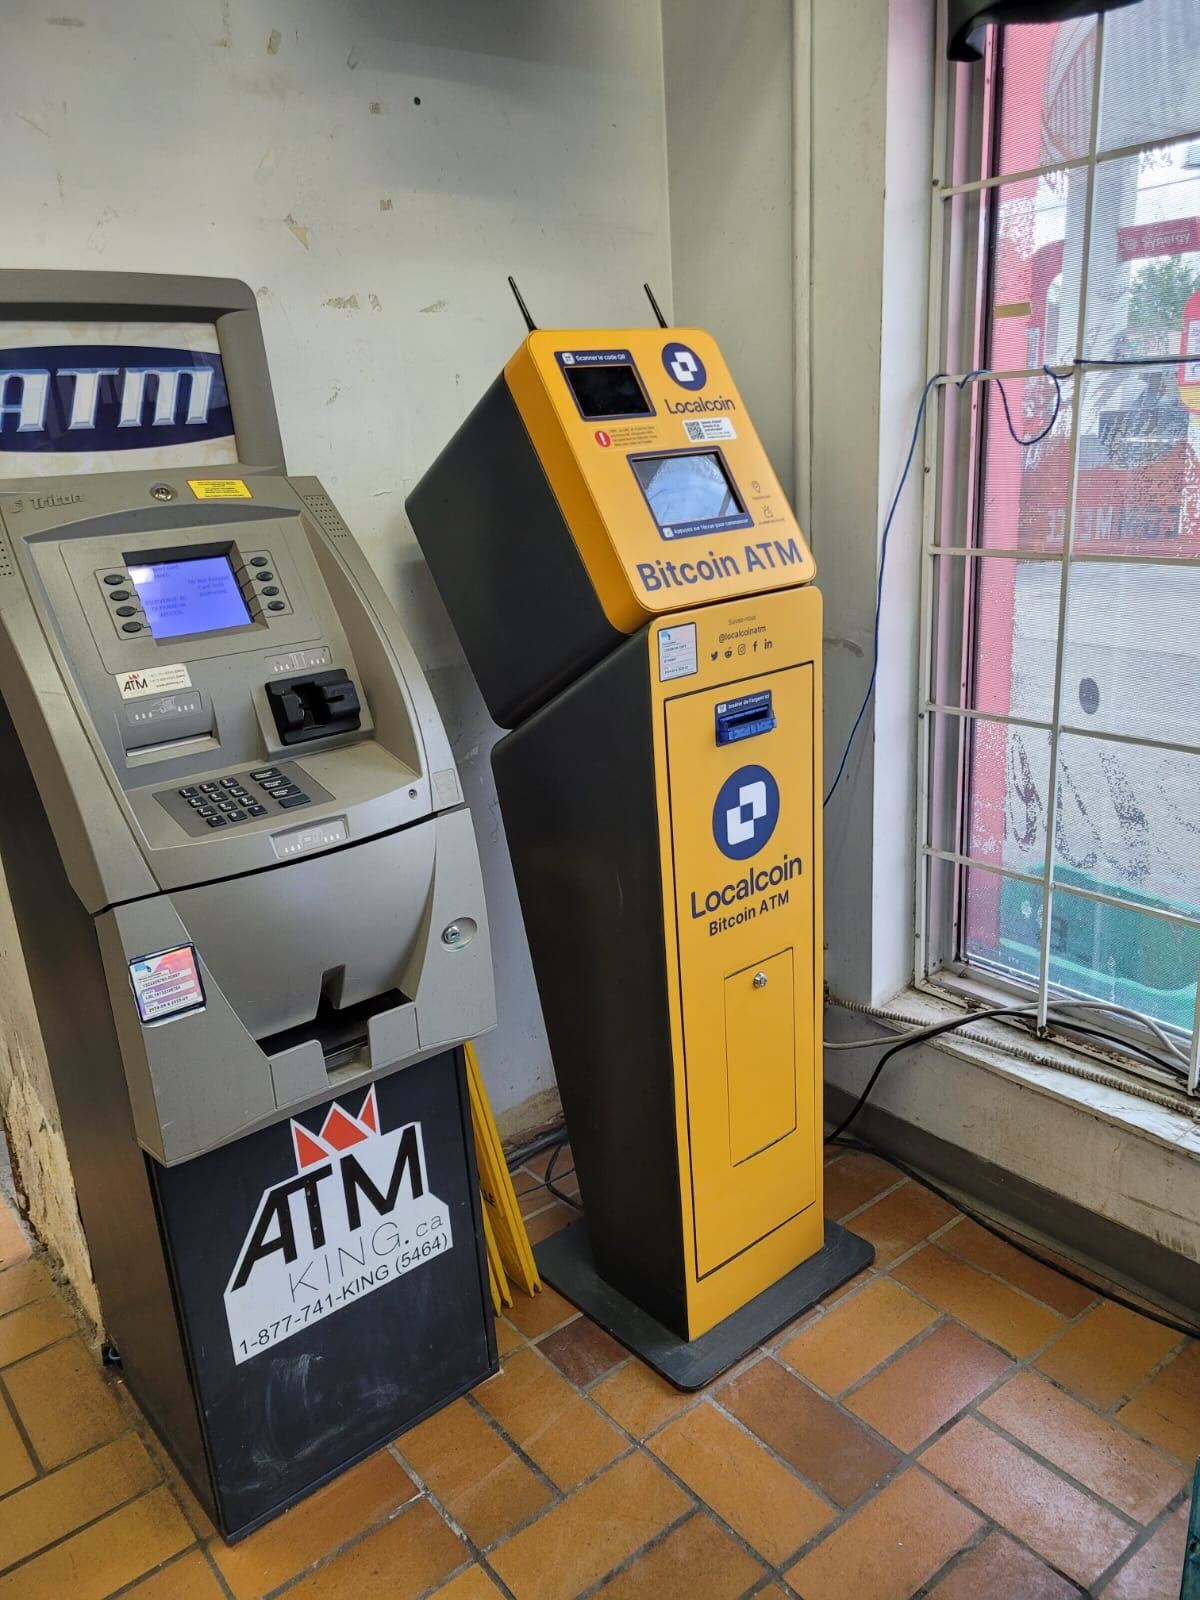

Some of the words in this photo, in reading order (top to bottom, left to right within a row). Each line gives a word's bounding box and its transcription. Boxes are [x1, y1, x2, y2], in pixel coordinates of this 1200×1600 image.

[0, 368, 214, 433] ATM
[664, 395, 736, 414] Localcoin
[636, 550, 741, 592] Bitcoin
[744, 538, 803, 572] ATM
[719, 625, 767, 643] @localcoinatm
[123, 678, 149, 692] ATM
[690, 854, 802, 919] Localcoin
[709, 906, 756, 936] Bitcoin
[759, 889, 789, 915] ATM
[231, 1124, 424, 1292] ATM
[239, 1264, 390, 1355] 1-877-741-KING
[395, 1232, 448, 1275] (5464)
